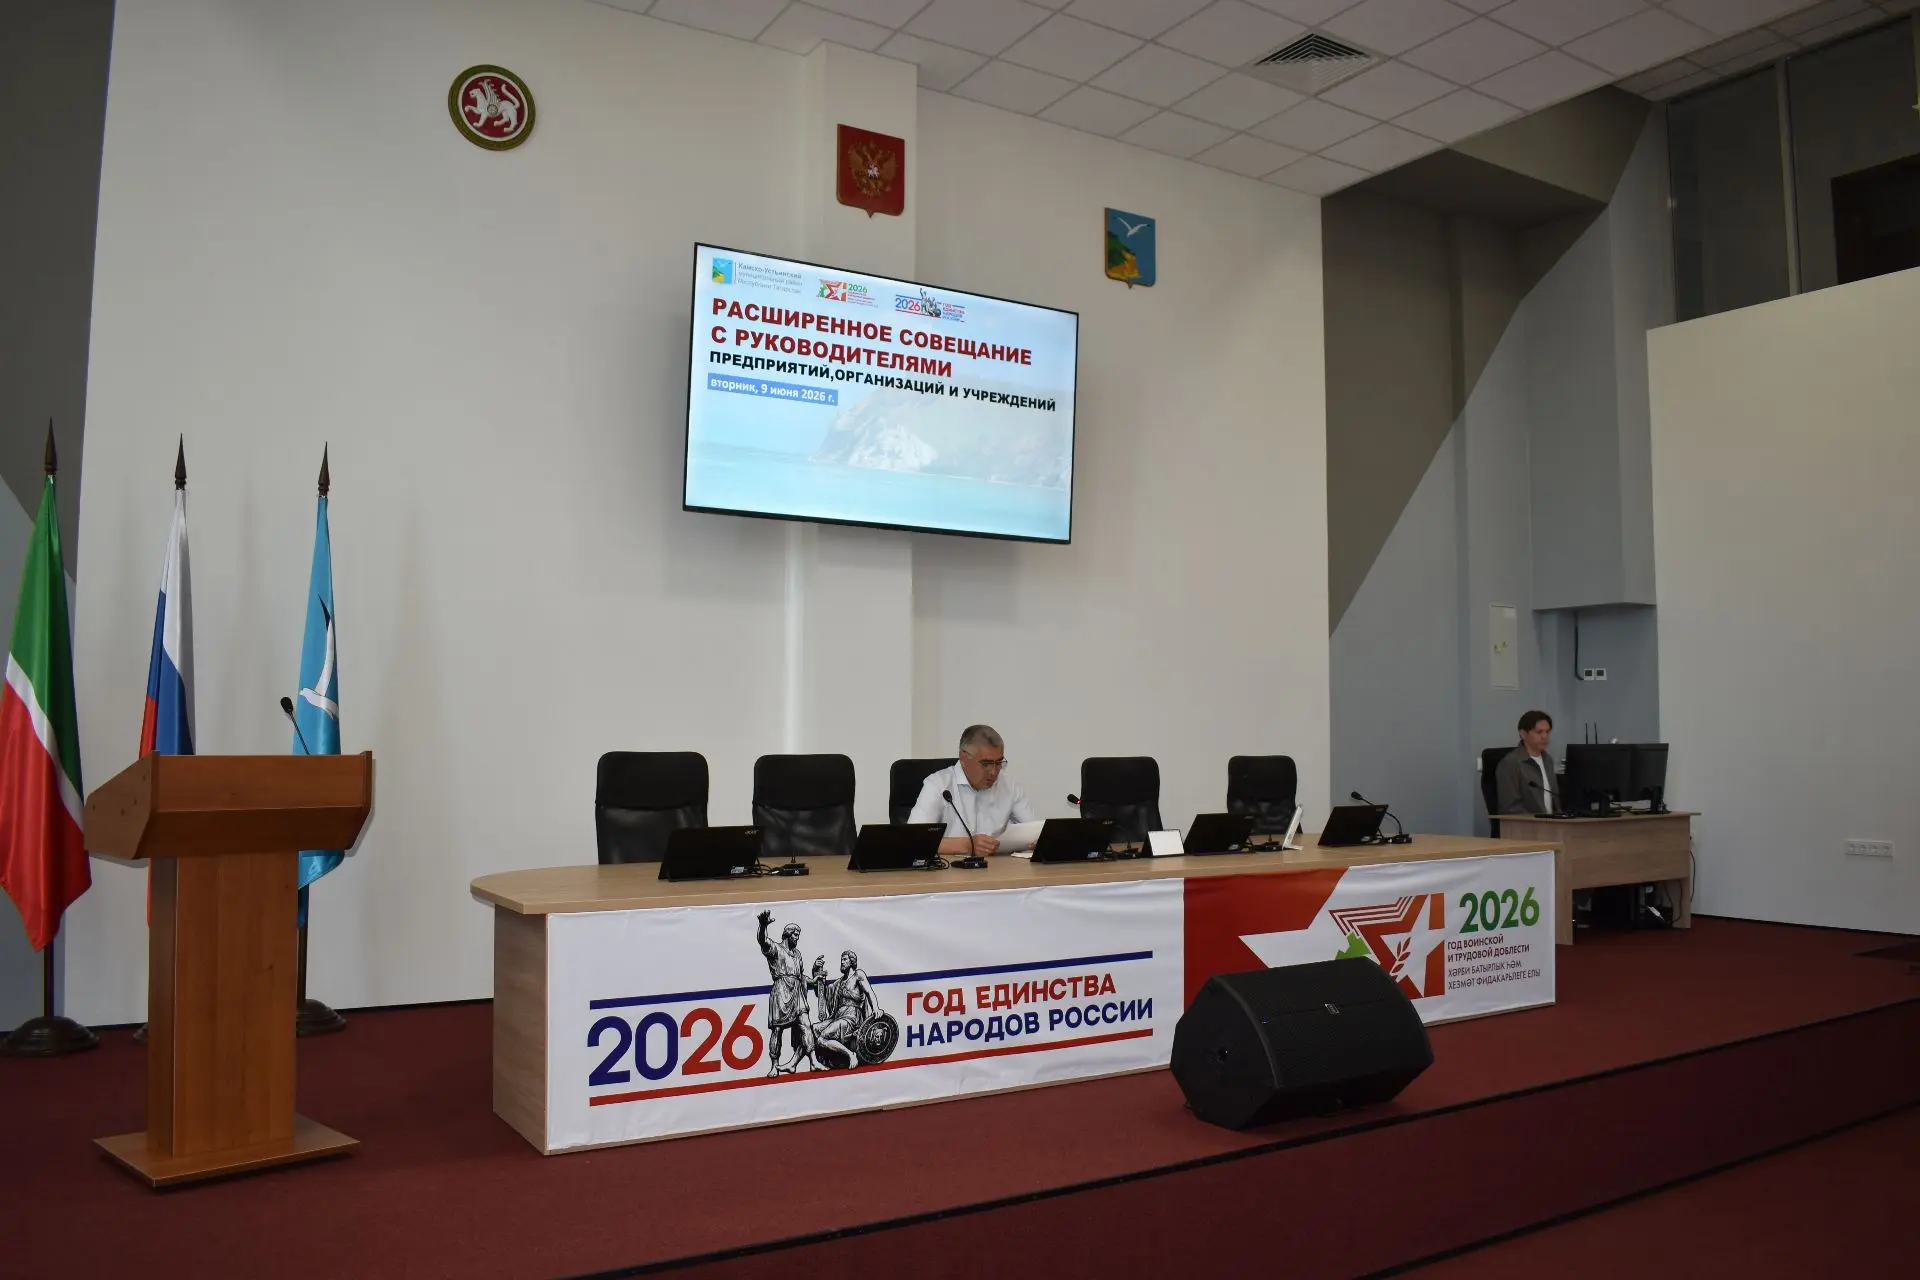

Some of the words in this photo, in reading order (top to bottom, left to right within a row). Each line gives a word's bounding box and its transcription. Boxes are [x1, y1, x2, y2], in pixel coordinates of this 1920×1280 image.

[848, 283, 868, 294] 2026
[895, 297, 921, 312] 2026
[712, 297, 892, 343] РАСШИРЕННОЕ
[899, 328, 1032, 366] СОВЕЩАНИЕ
[711, 325, 727, 344] С
[735, 328, 952, 378] РУКОВОДИТЕЛЯМИ
[710, 377, 758, 395] вторник,
[761, 383, 768, 395] 9
[770, 388, 799, 399] июня
[801, 388, 827, 402] 2026
[828, 395, 835, 403] г.
[949, 385, 959, 397] И
[962, 387, 1057, 412] УЧРЕЖДЕНИЙ
[1459, 886, 1540, 934] 2026
[1447, 940, 1462, 951] ГОД
[1463, 934, 1504, 949] ВОИНСКОЙ
[1447, 953, 1454, 963] И
[1455, 947, 1493, 962] ТРУДОВОЙ
[1494, 944, 1530, 957] ДОБЛЕСТИ
[1448, 966, 1471, 978] ХӘРБИ
[1471, 962, 1505, 975] БАТЫРЛЫК
[1448, 978, 1475, 990] ХЕЗМӘТ
[1476, 970, 1526, 986] ФИДАКАРЬЛЕГЕ
[1527, 969, 1541, 978] ЕЛЫ
[906, 987, 966, 1016] ГОД
[976, 973, 1117, 1012] ЕДИНСТВА
[906, 1011, 1040, 1048] НАРОДОВ
[1049, 997, 1153, 1031] РОССИИ
[586, 1003, 764, 1087] 2026
